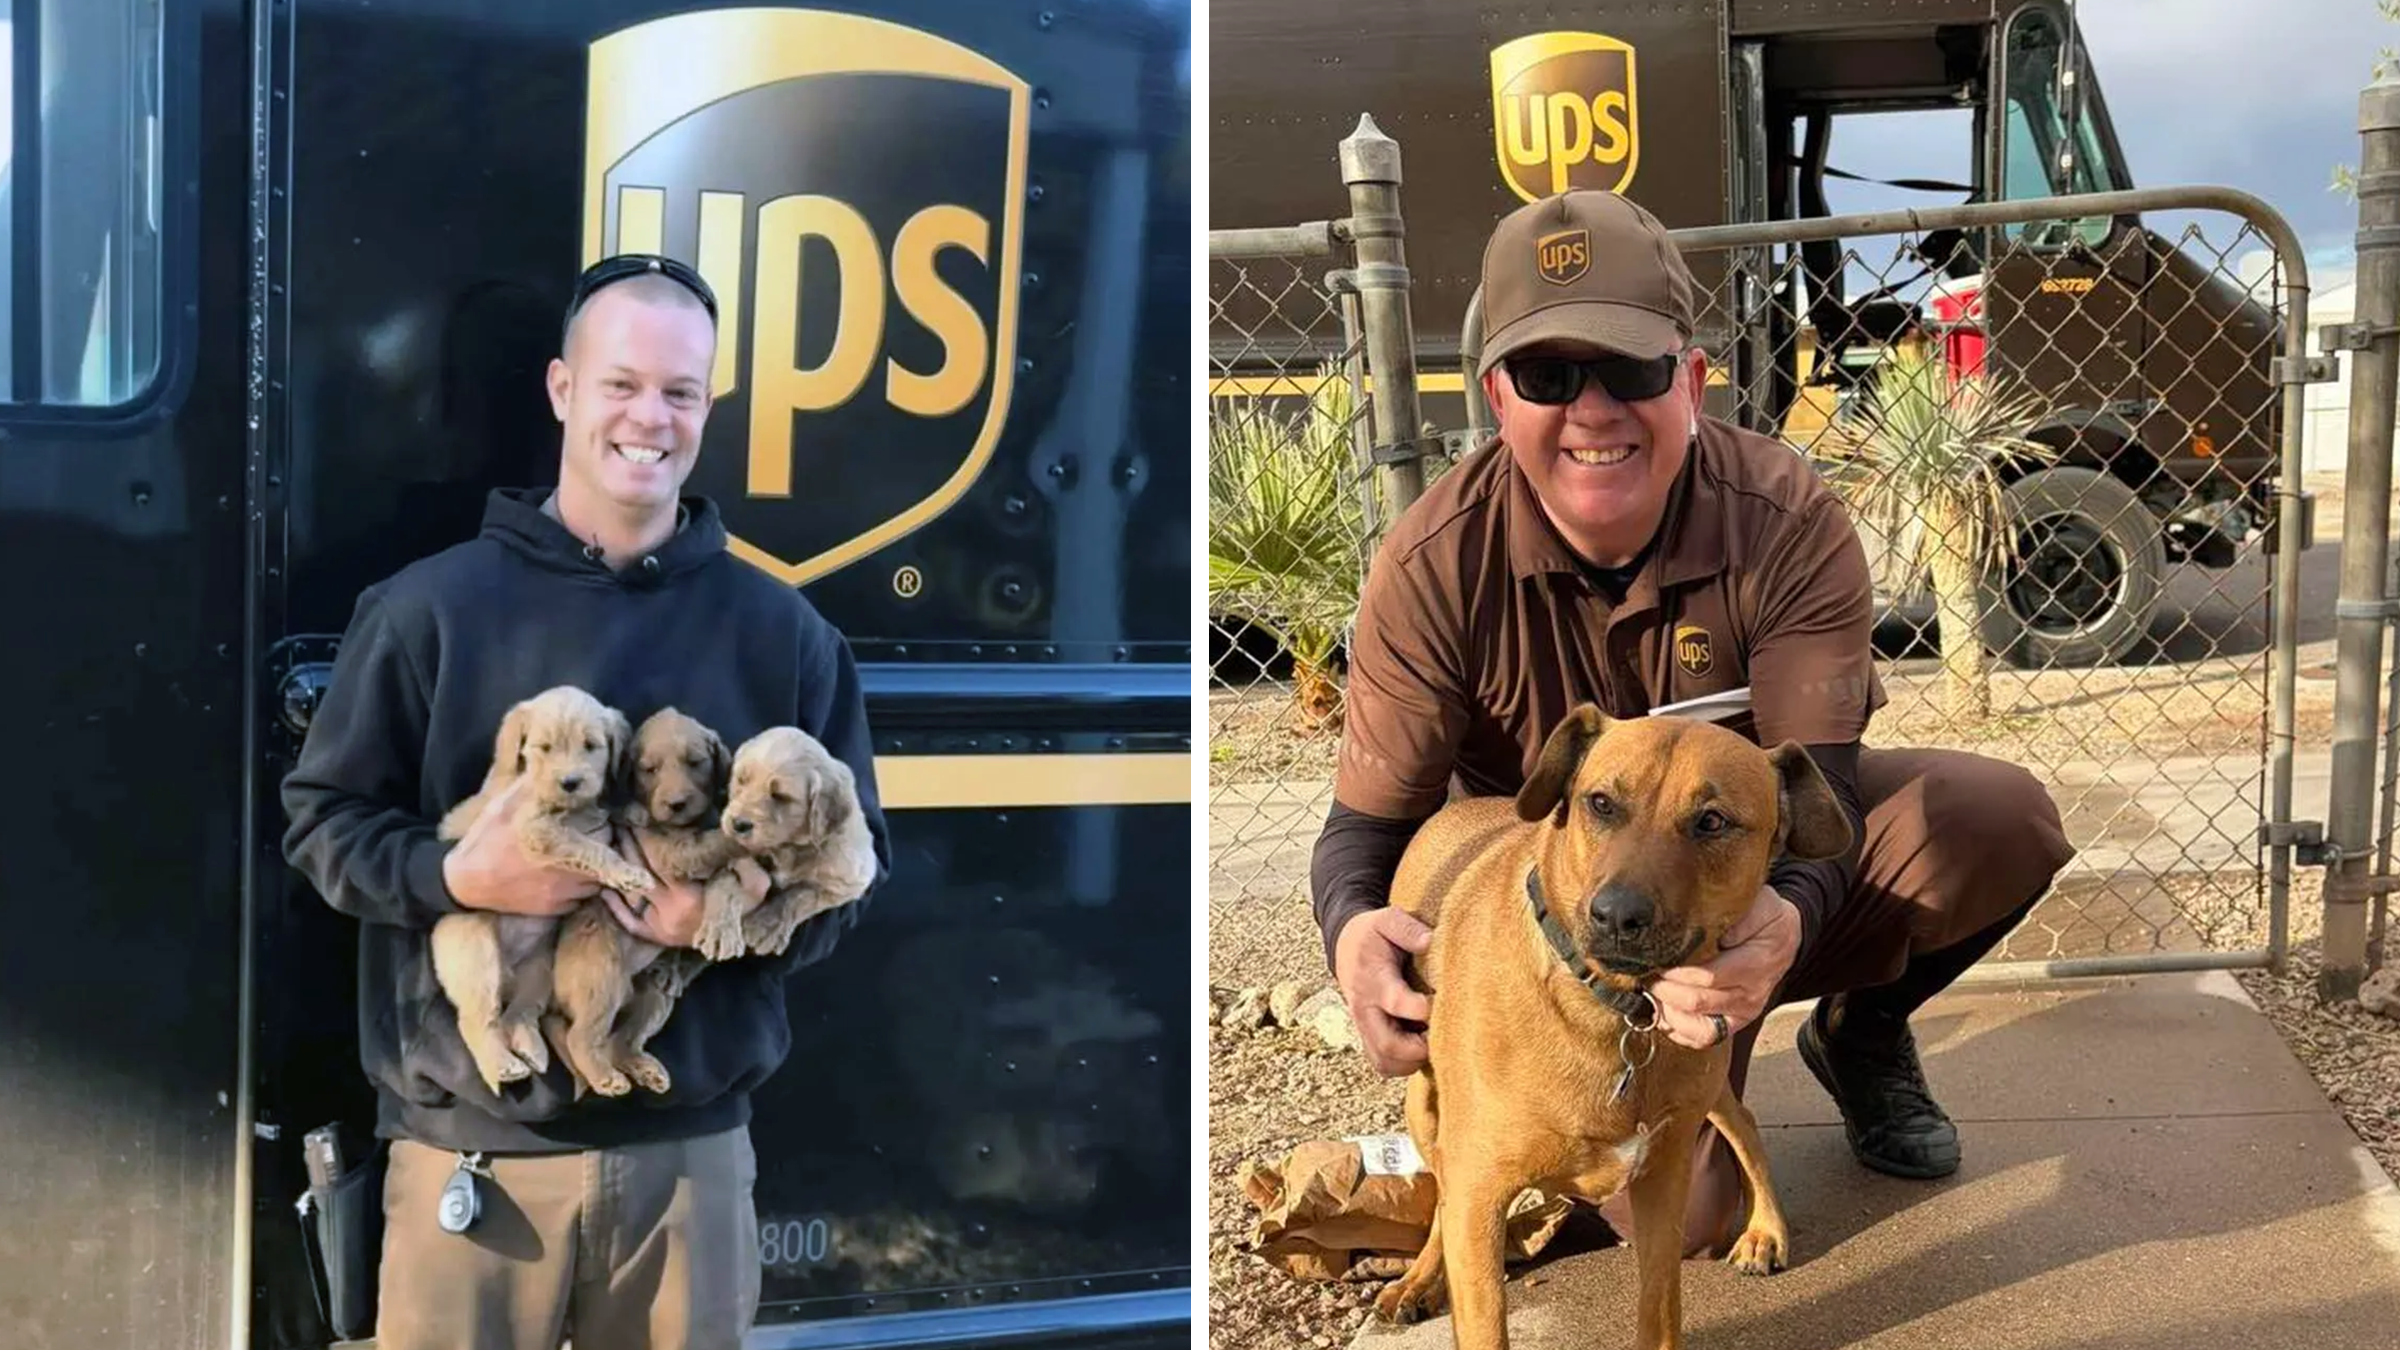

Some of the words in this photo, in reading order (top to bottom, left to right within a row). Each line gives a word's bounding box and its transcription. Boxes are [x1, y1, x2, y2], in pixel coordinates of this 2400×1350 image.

[1504, 90, 1630, 194] ups
[1542, 243, 1586, 276] ups
[616, 185, 990, 498] ups
[1680, 641, 1710, 670] ups
[760, 1218, 827, 1265] 800
